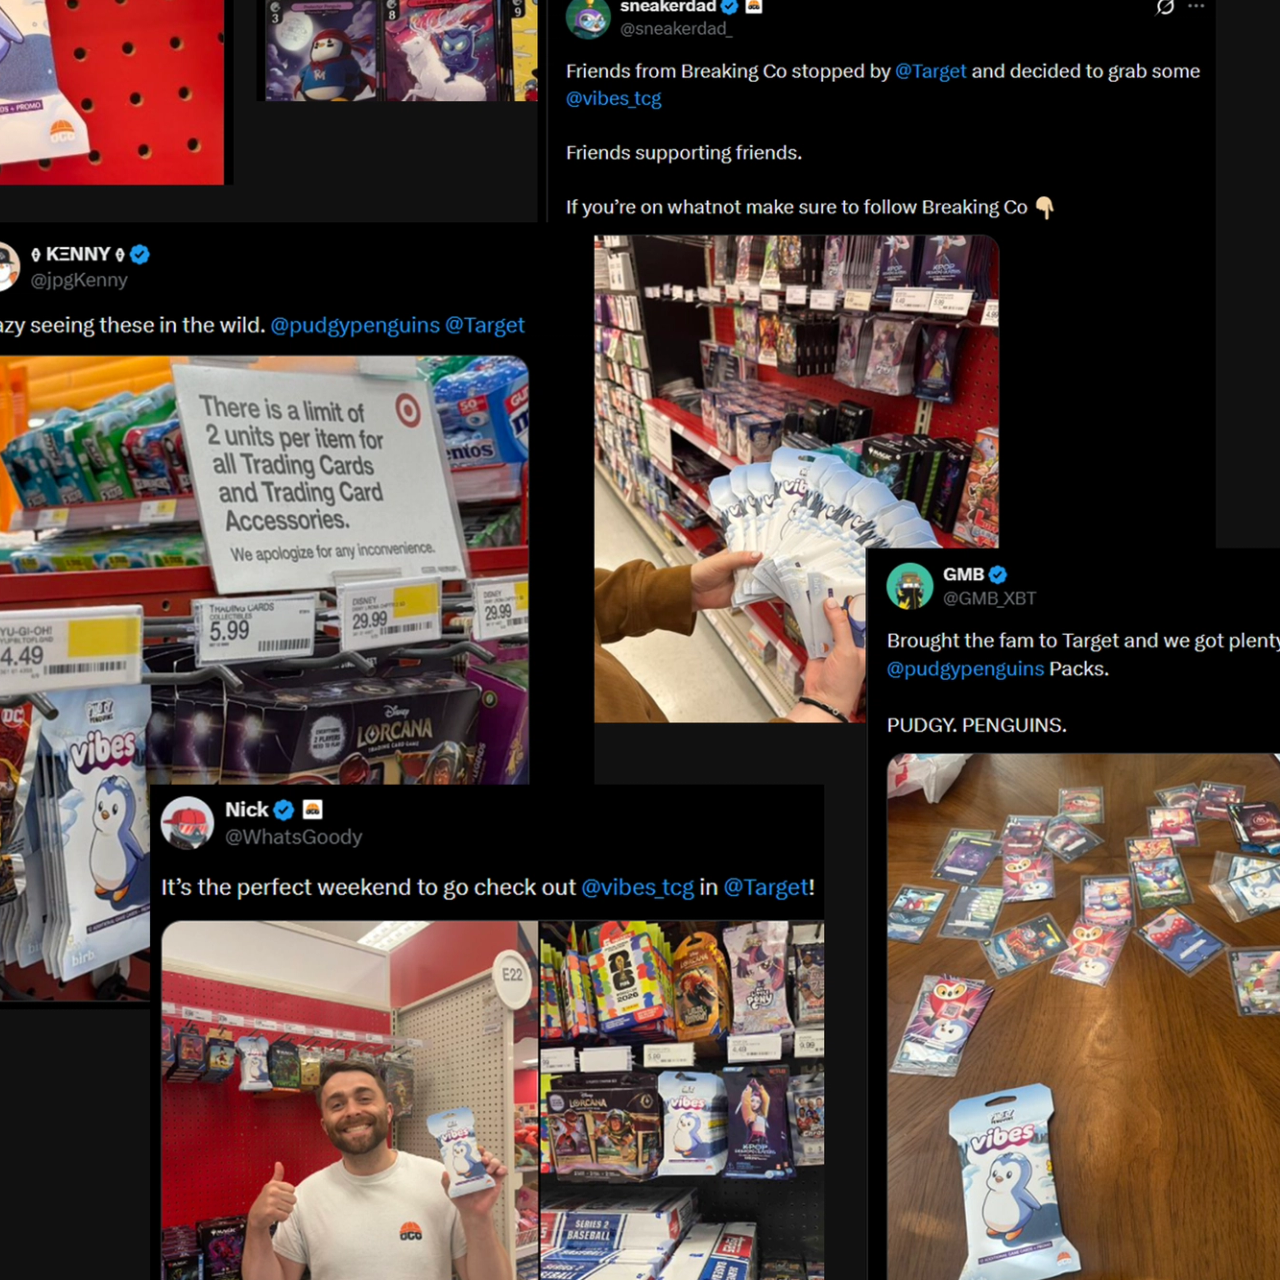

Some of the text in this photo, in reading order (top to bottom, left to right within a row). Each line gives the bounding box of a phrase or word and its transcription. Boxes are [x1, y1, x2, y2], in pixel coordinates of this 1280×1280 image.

[31, 272, 128, 290] @jpgKenny
[199, 394, 365, 423] There is a limit of
[205, 424, 384, 452] 2 units per item for
[212, 452, 375, 480] all Trading Cards
[218, 481, 384, 507] and Trading Card
[225, 510, 350, 532] Accessories.
[231, 541, 436, 563] We apologize for any inconvenience.
[944, 568, 984, 581] GMB
[352, 611, 388, 630] 29.99
[485, 604, 513, 620] 29.99
[209, 620, 250, 642] 5.99
[0, 646, 44, 667] 4.49
[357, 717, 433, 747] LORCANA
[888, 718, 1066, 732] PUDGY. PENGUINS.
[70, 730, 137, 775] vibes
[226, 801, 269, 817] Nick
[226, 828, 362, 848] @WhatsGoody
[502, 968, 523, 981] E22
[670, 1095, 707, 1110] vibes
[970, 1123, 1035, 1155] vibes
[575, 1217, 609, 1228] SERIES 2
[567, 1229, 611, 1241] BASEBALL
